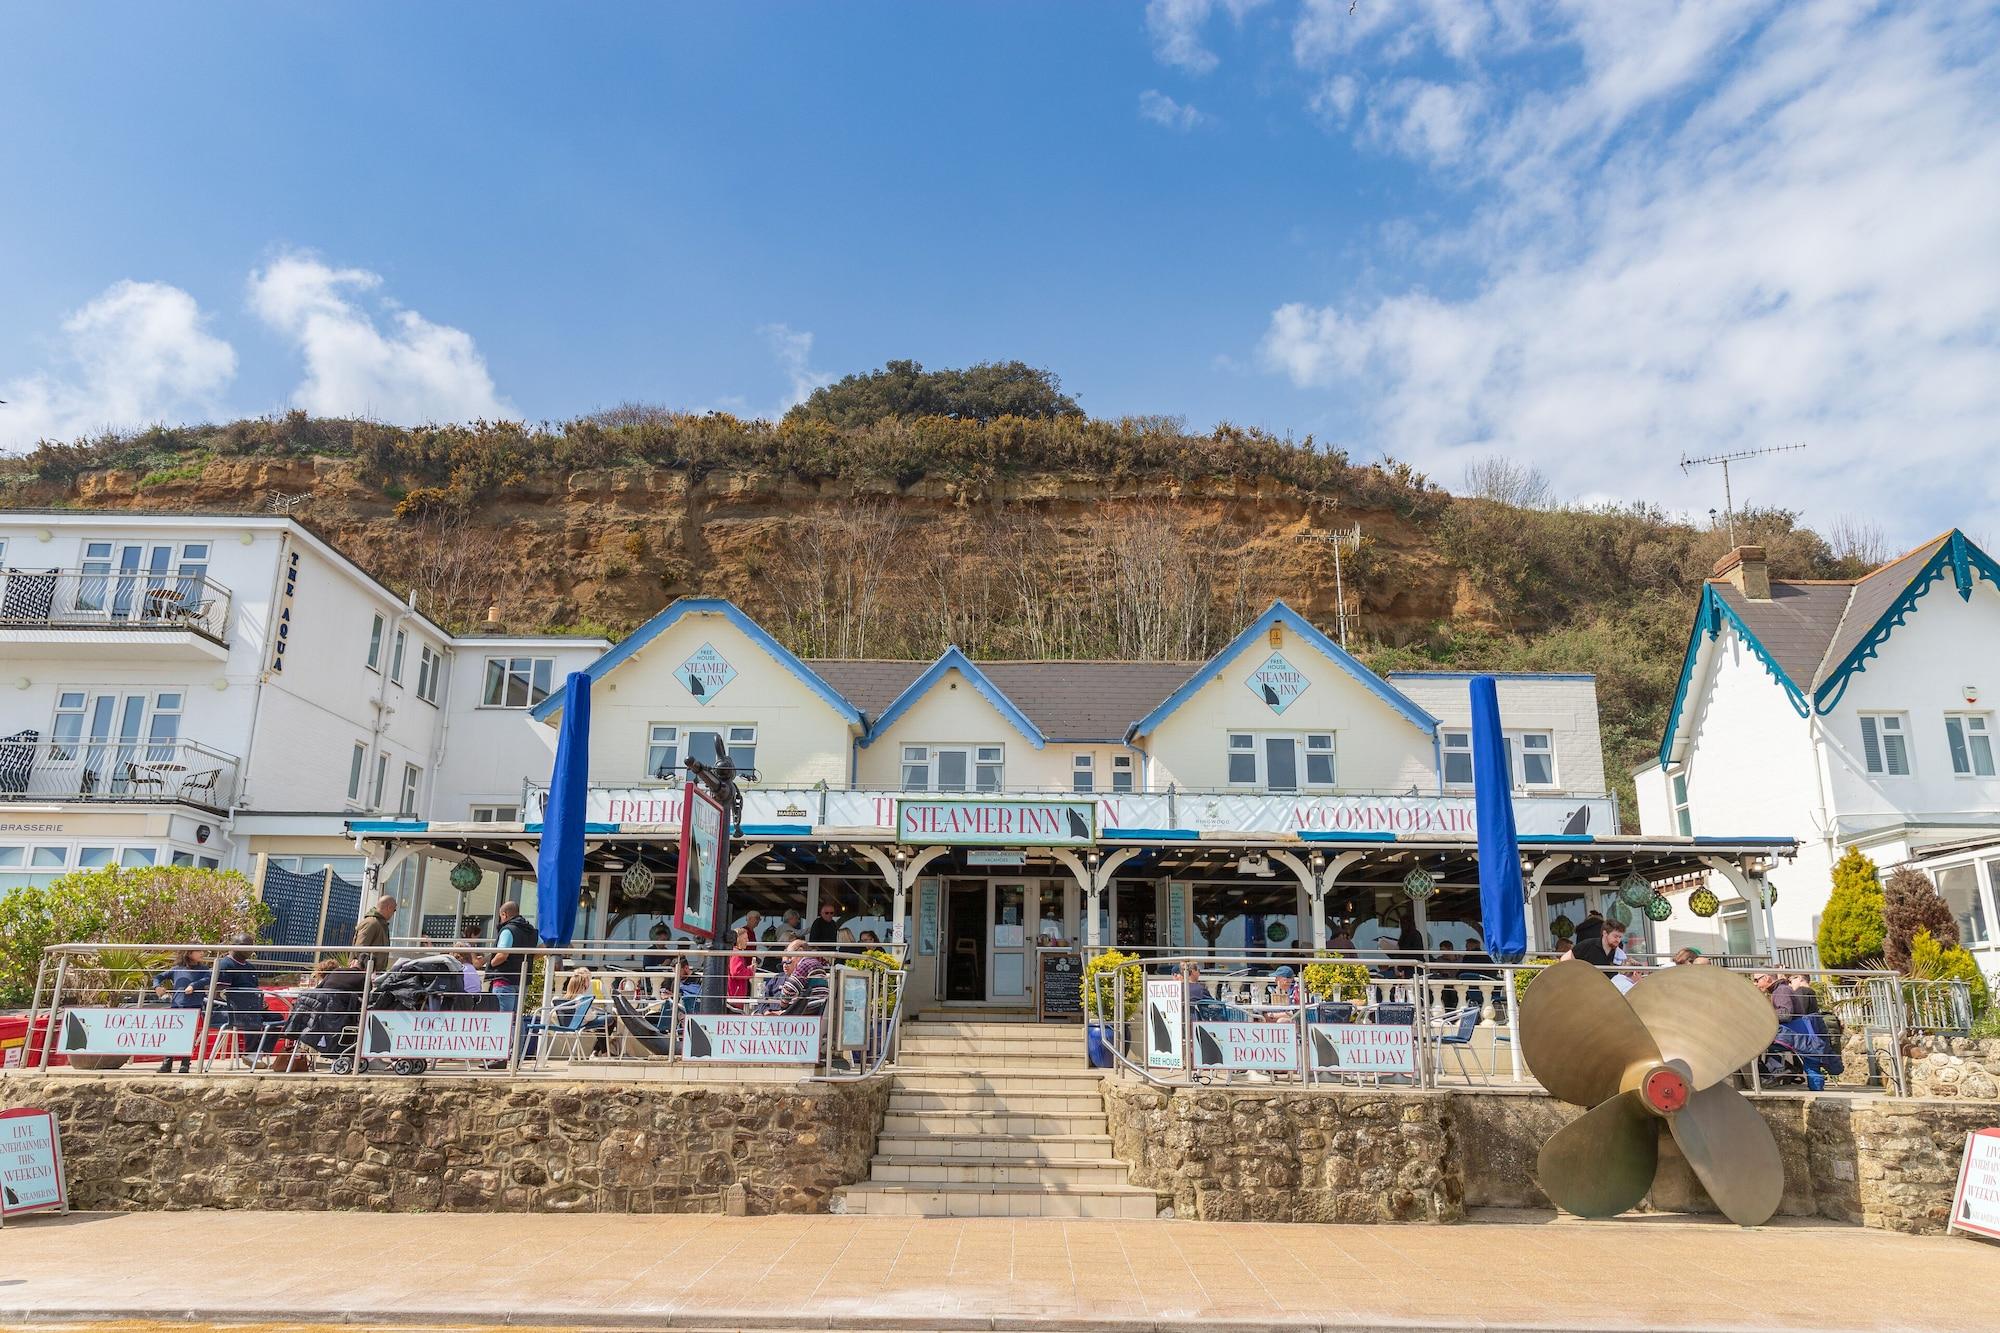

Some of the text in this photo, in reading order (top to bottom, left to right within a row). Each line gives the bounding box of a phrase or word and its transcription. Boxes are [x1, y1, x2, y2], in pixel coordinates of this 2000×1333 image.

[273, 551, 299, 671] THE AQUA
[684, 662, 728, 673] STEAMER
[707, 675, 725, 686] INN
[1255, 672, 1300, 683] STEAMER
[1280, 684, 1298, 695] INN
[0, 823, 63, 832] BRASSERIE
[905, 806, 1061, 834] STEAMER INN
[1149, 984, 1179, 998] STEAMER
[1166, 999, 1179, 1013] INN
[104, 1014, 185, 1030] LOCAL ALES
[413, 1016, 492, 1033] LOCAL LIVE
[717, 1021, 816, 1037] BEST SEAFOOD
[117, 1033, 166, 1048] ON TAP
[396, 1035, 506, 1051] ENTERTAINMENT
[1229, 1027, 1290, 1044] EN-SUITE
[1341, 1030, 1409, 1046] HOT FOOD
[721, 1040, 809, 1056] IN SHANKLIN
[1234, 1047, 1286, 1063] ROOMS
[1149, 1056, 1180, 1067] FREE HOUSE
[1347, 1049, 1406, 1065] ALL DAY
[13, 1124, 35, 1139] LIVE
[18, 1154, 36, 1166] THIS
[4, 1165, 51, 1182] WEEKEND
[1982, 1174, 1997, 1186] THIS
[20, 1190, 46, 1201] STEAMER
